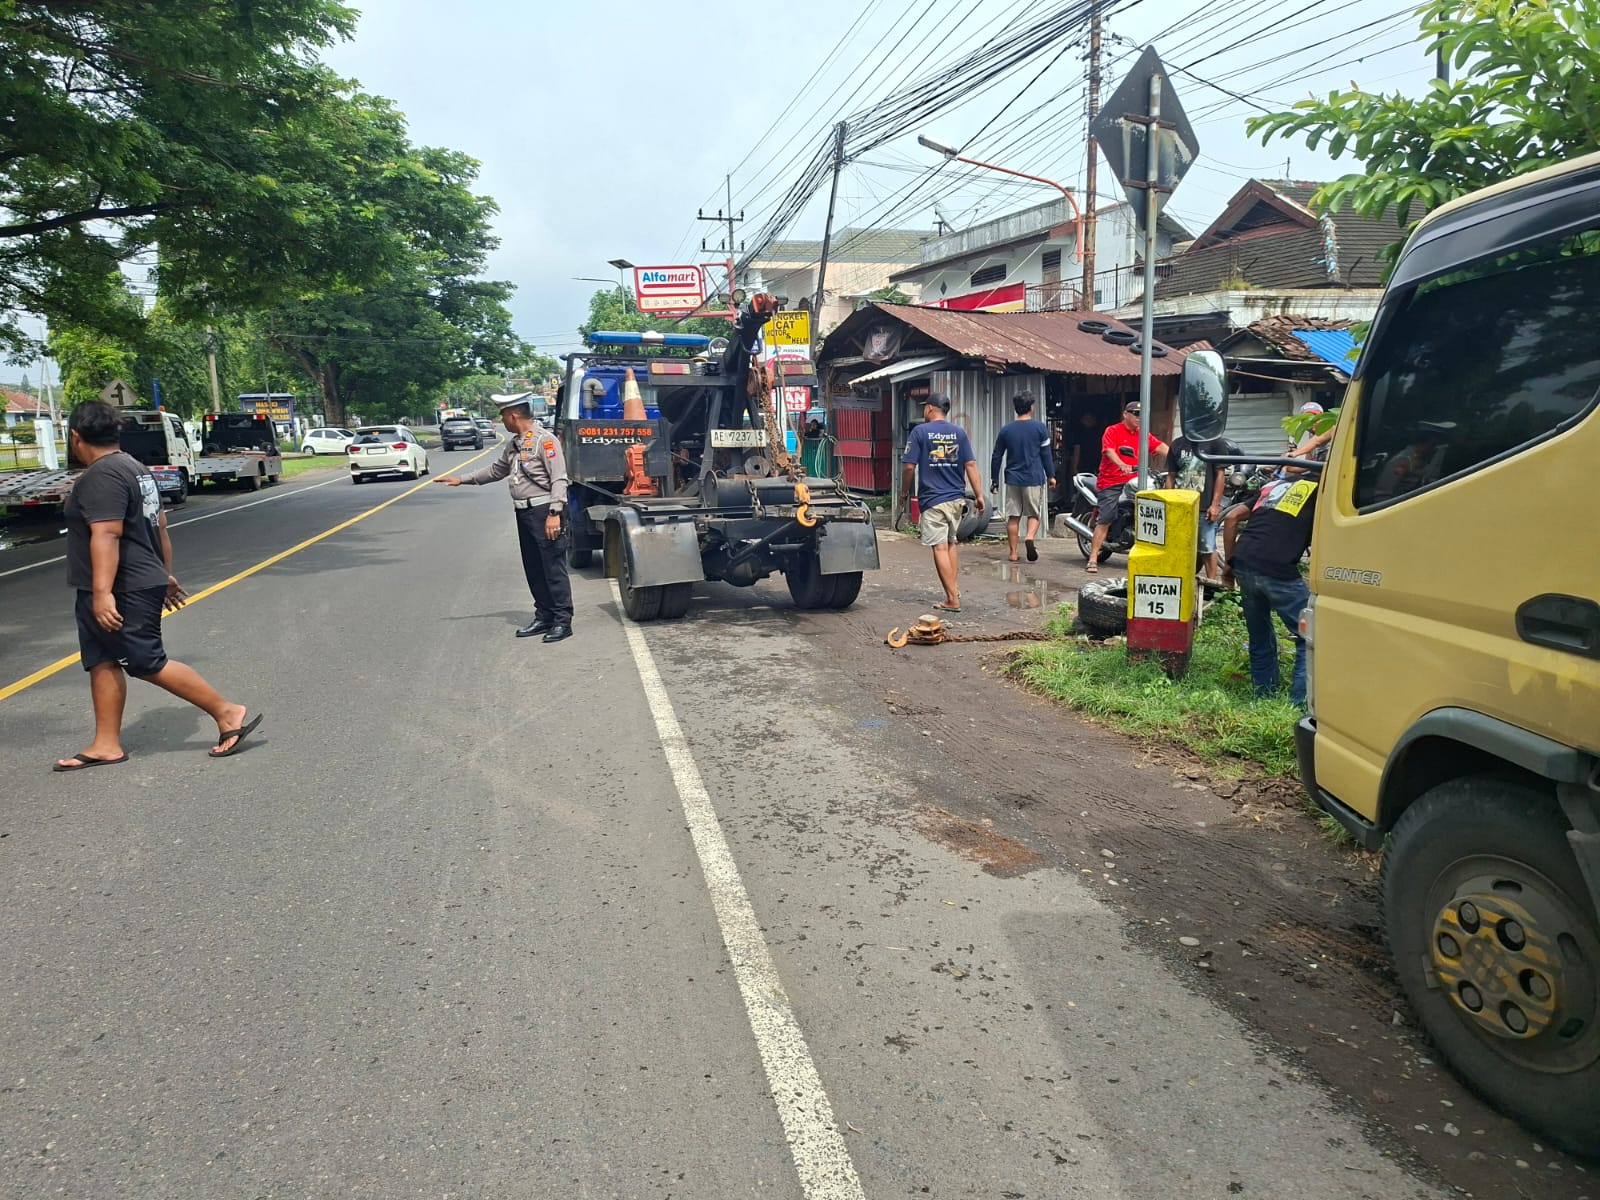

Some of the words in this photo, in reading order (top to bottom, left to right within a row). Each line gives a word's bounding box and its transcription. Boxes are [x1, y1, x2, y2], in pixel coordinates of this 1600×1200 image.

[643, 271, 696, 282] Alfamart
[776, 320, 796, 330] CAT
[791, 337, 809, 345] HELM
[586, 427, 601, 436] 081
[603, 427, 618, 436] 231
[620, 427, 635, 436] 757
[714, 431, 724, 441] AE
[729, 431, 752, 441] 7237
[758, 431, 763, 441] S
[1139, 505, 1163, 521] S.BAYA
[1142, 522, 1158, 536] 178
[1325, 566, 1382, 587] CANTER
[1137, 583, 1177, 596] M.GTAN
[1148, 601, 1165, 615] 15
